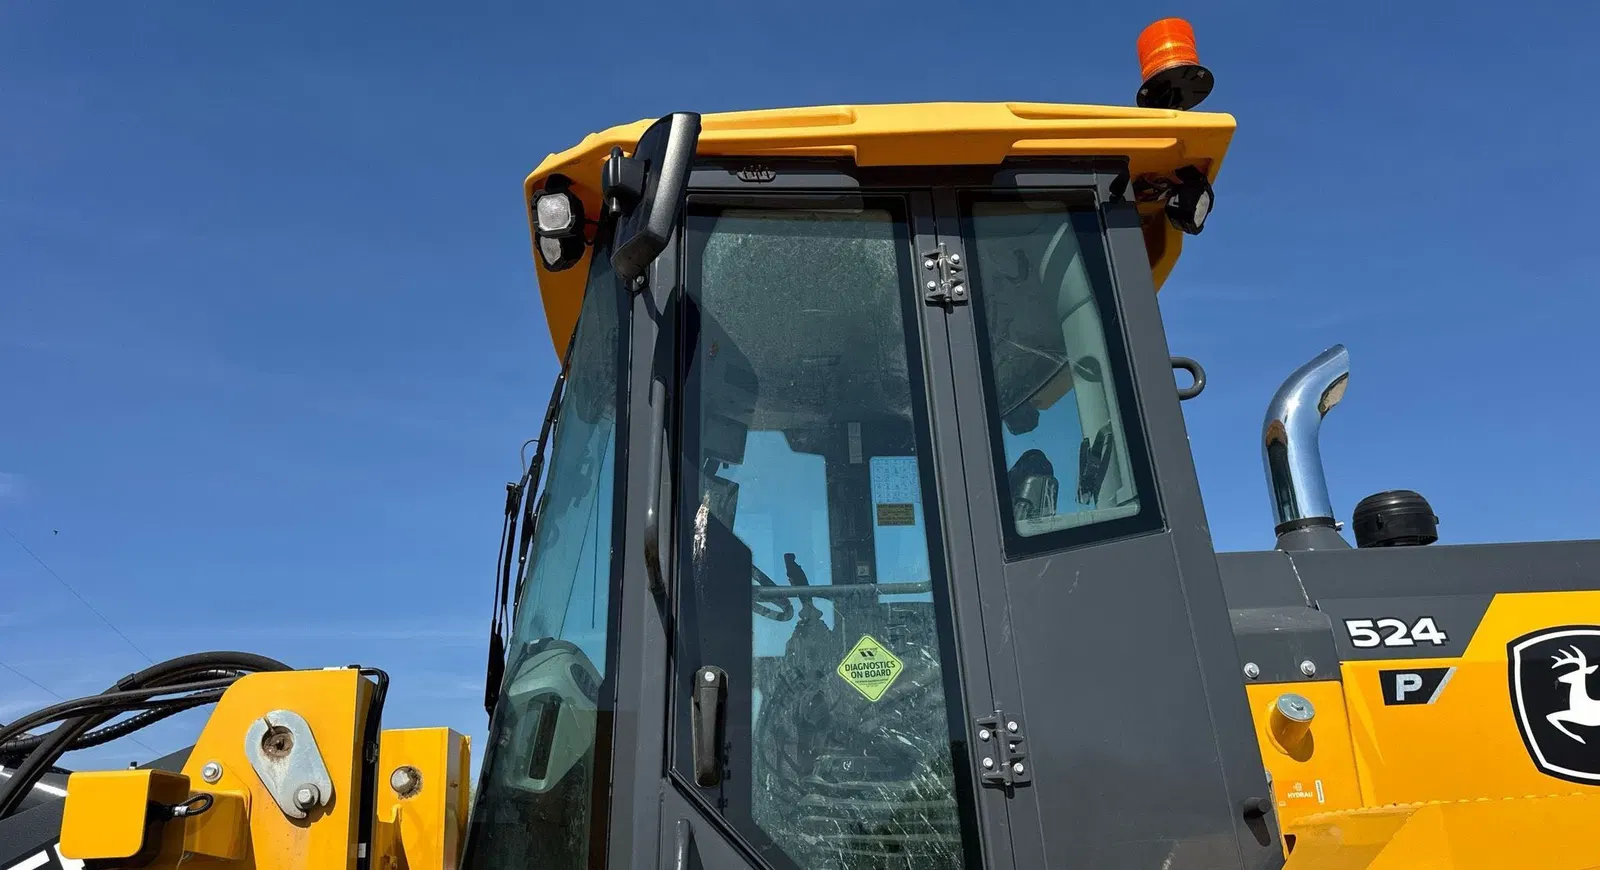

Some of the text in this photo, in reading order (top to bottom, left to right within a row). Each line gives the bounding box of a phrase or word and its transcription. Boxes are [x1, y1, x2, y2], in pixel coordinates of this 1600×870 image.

[1343, 616, 1448, 648] 524
[845, 661, 895, 671] DIAGNOSTICS
[850, 669, 891, 679] ON BOARD
[1396, 673, 1423, 701] P
